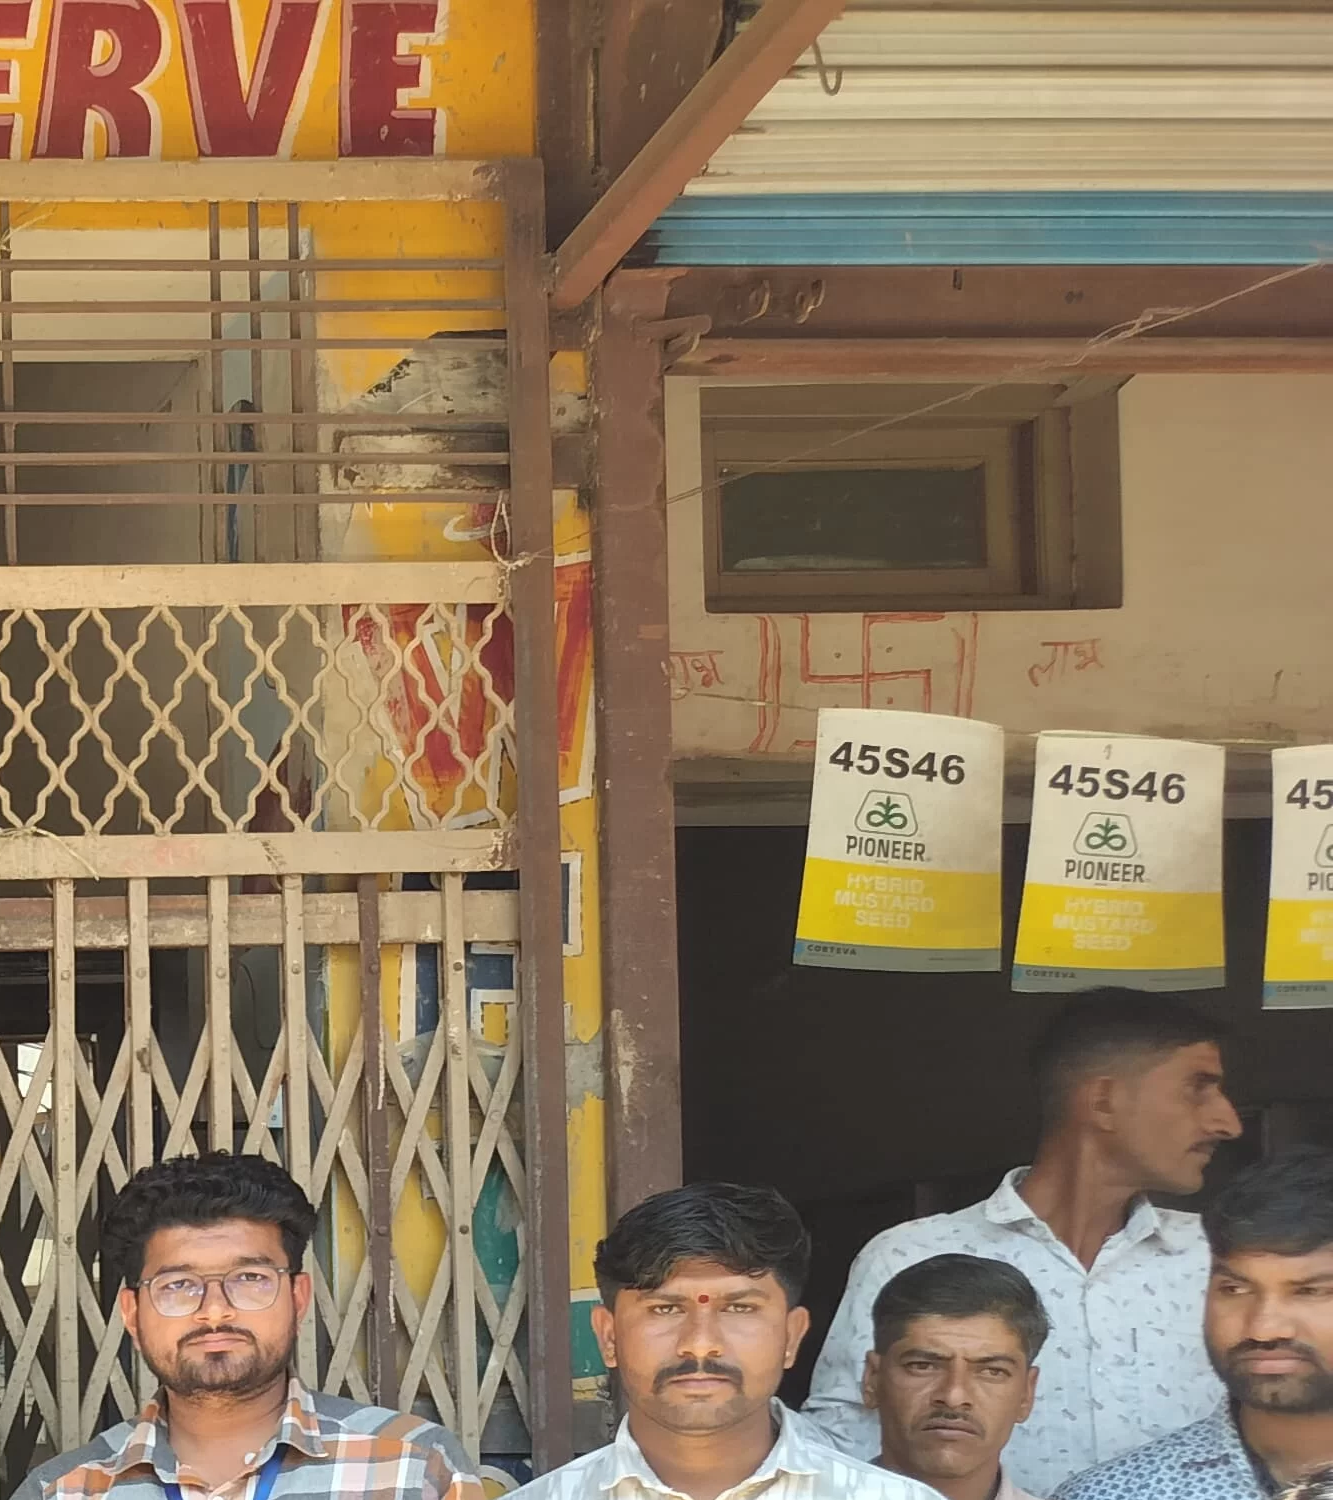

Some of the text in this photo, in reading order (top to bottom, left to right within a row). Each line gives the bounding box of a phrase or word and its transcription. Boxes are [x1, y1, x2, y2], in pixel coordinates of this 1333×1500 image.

[829, 740, 966, 786] 45S46
[1048, 764, 1187, 805] 45S46
[845, 834, 927, 863] PIONEER
[847, 872, 925, 895] HYBRID
[1064, 858, 1146, 884] PIONEER
[834, 889, 936, 913] MUSTARD
[854, 910, 912, 930] SEED
[806, 943, 858, 957] CORTEVA
